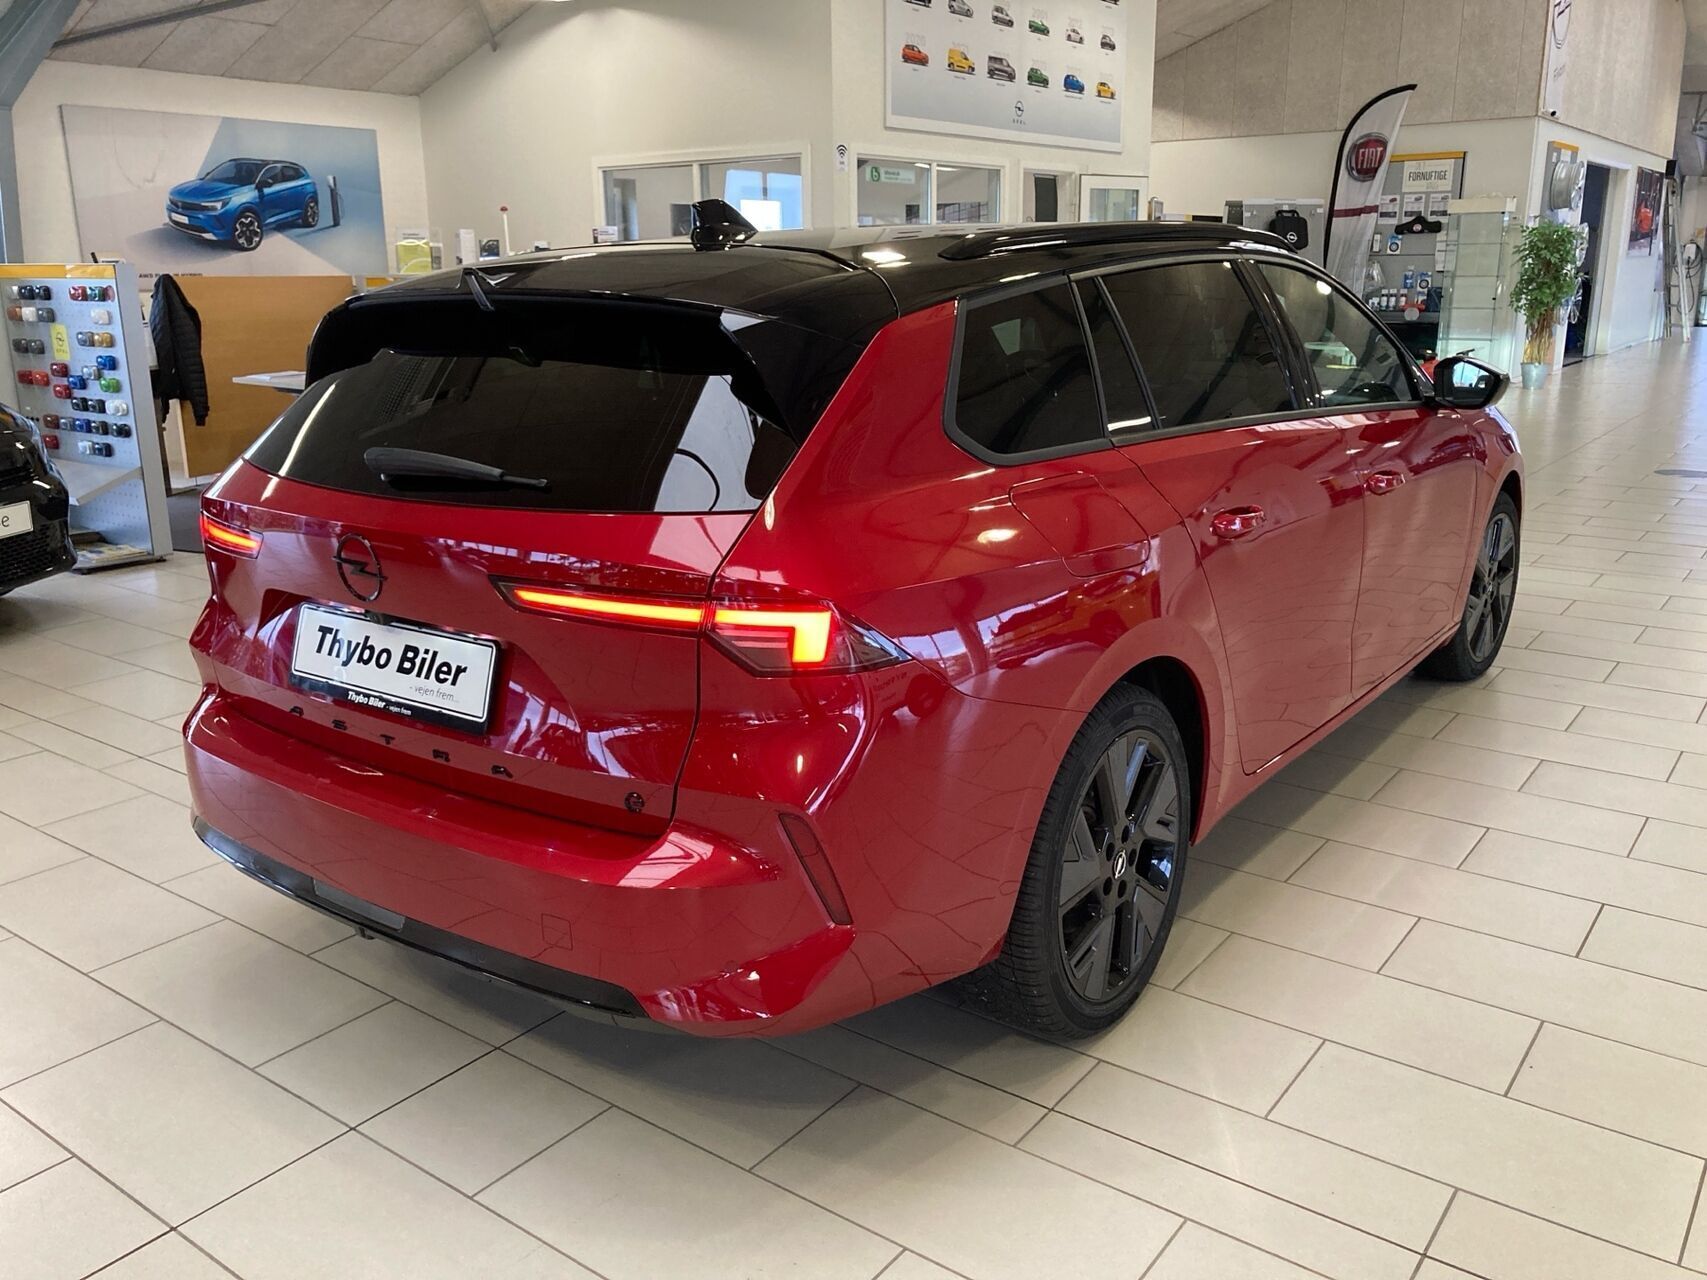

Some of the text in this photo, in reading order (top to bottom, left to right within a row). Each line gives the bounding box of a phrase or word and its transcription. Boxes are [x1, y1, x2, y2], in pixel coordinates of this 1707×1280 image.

[1358, 147, 1384, 169] FIAT
[1408, 170, 1448, 182] FORNUFTIGE
[316, 625, 468, 687] Thybo Biler
[347, 691, 368, 704] Thybo
[368, 696, 386, 709] Biler
[414, 686, 435, 697] vejen
